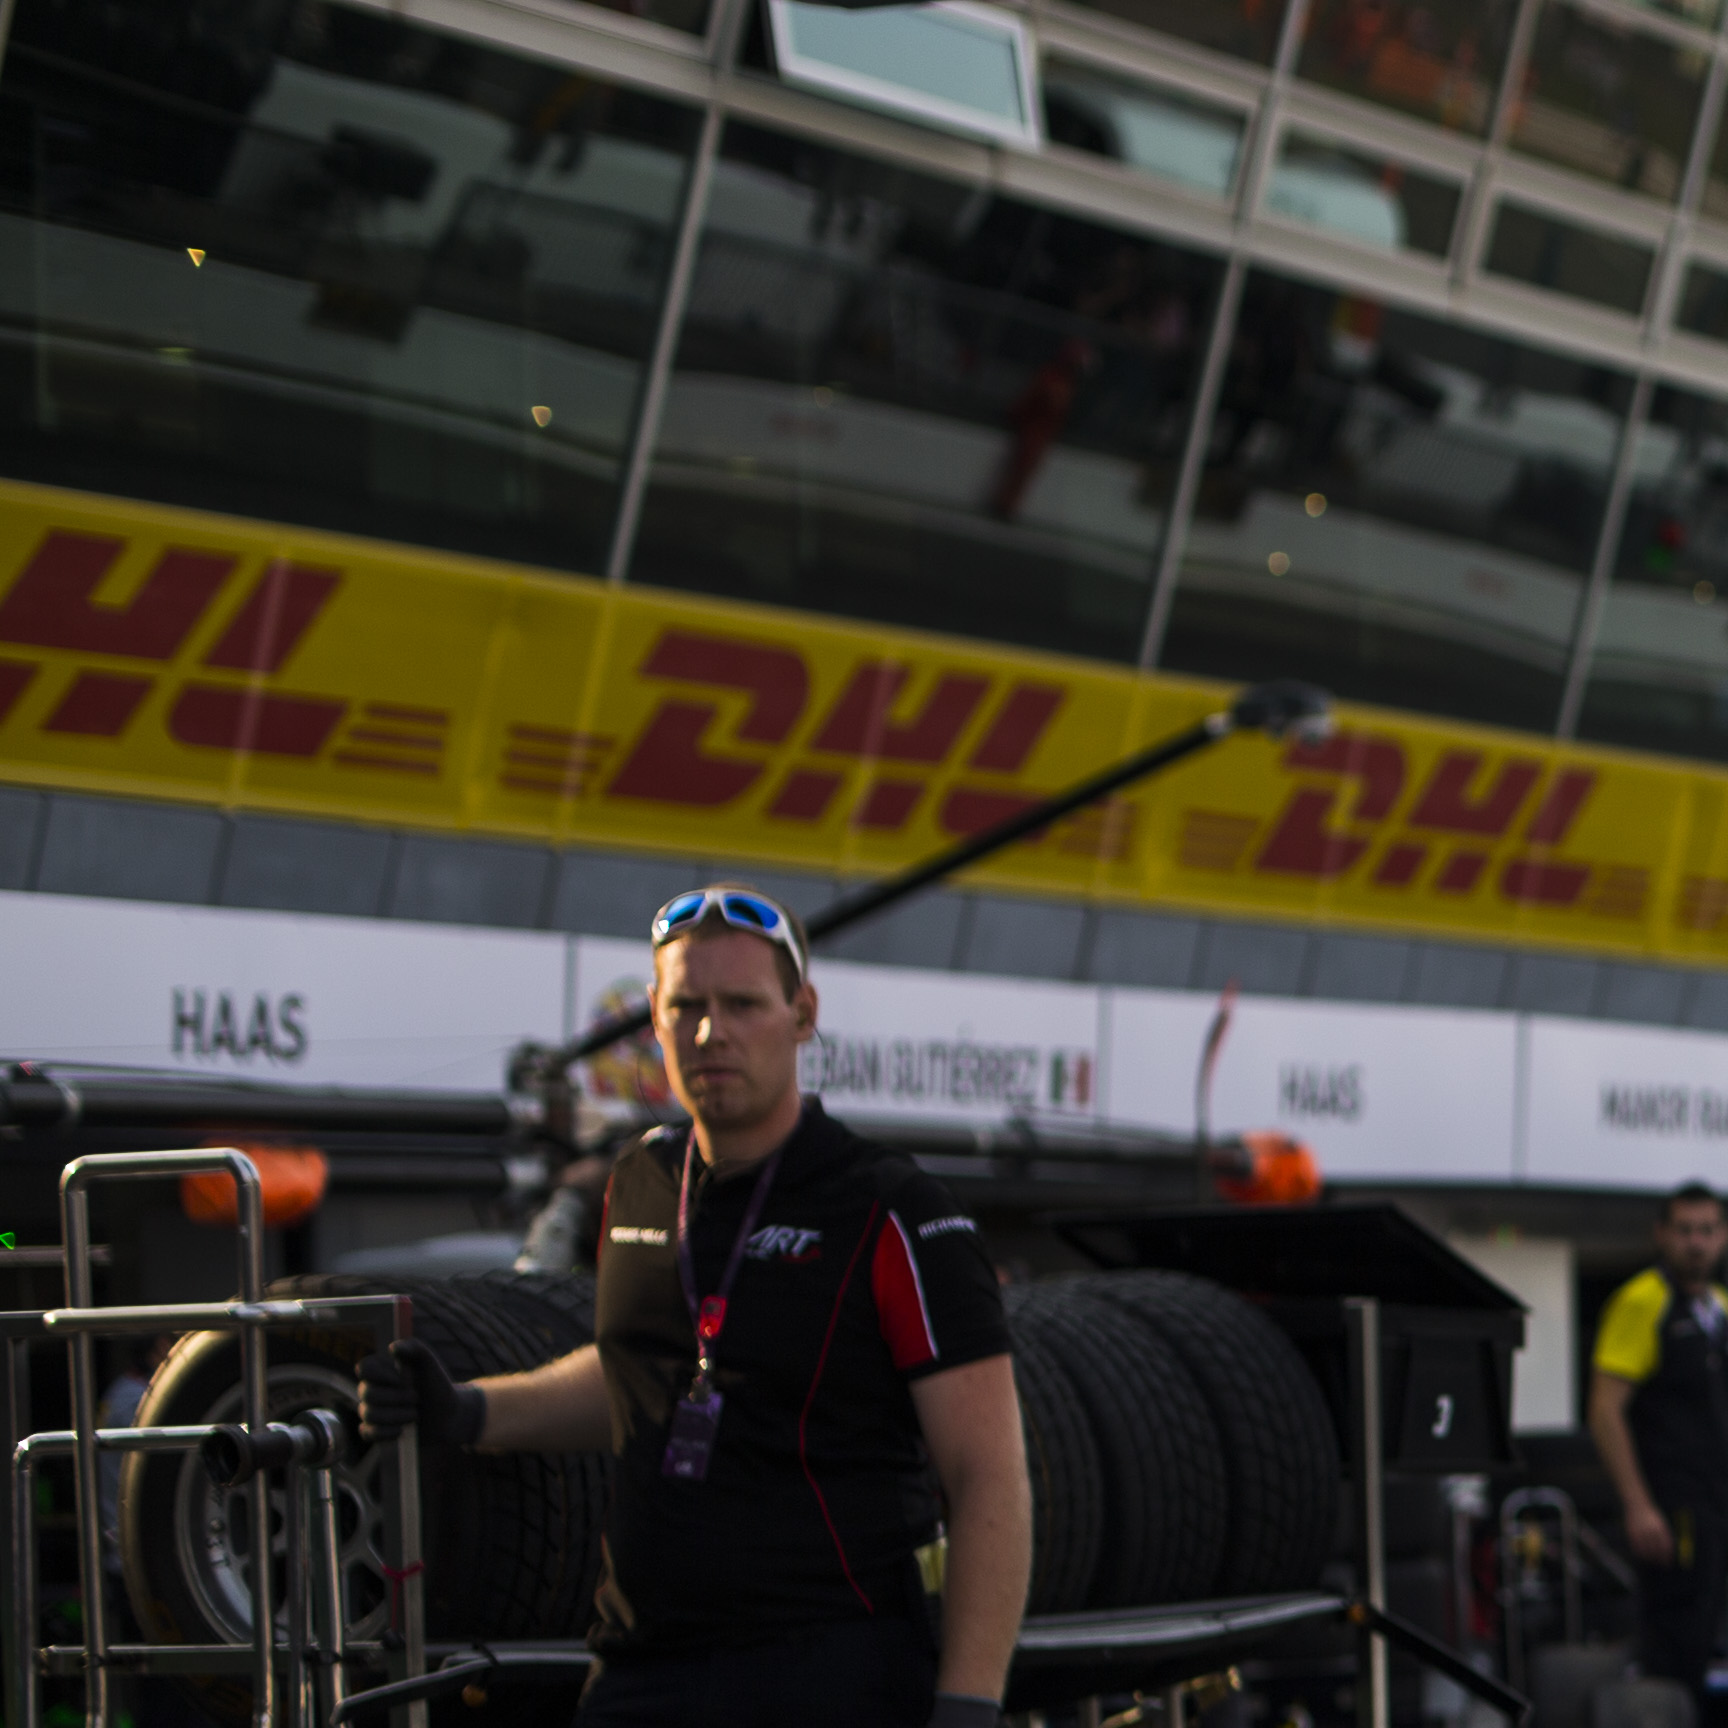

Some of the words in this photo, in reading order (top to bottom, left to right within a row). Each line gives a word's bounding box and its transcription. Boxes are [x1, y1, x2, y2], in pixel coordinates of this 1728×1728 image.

[0, 528, 346, 758] HL
[605, 626, 1072, 850] DHL
[1254, 728, 1600, 906] DHL
[171, 984, 310, 1064] HAAS
[1279, 1058, 1364, 1122] HAAS
[748, 1224, 822, 1258] ART
